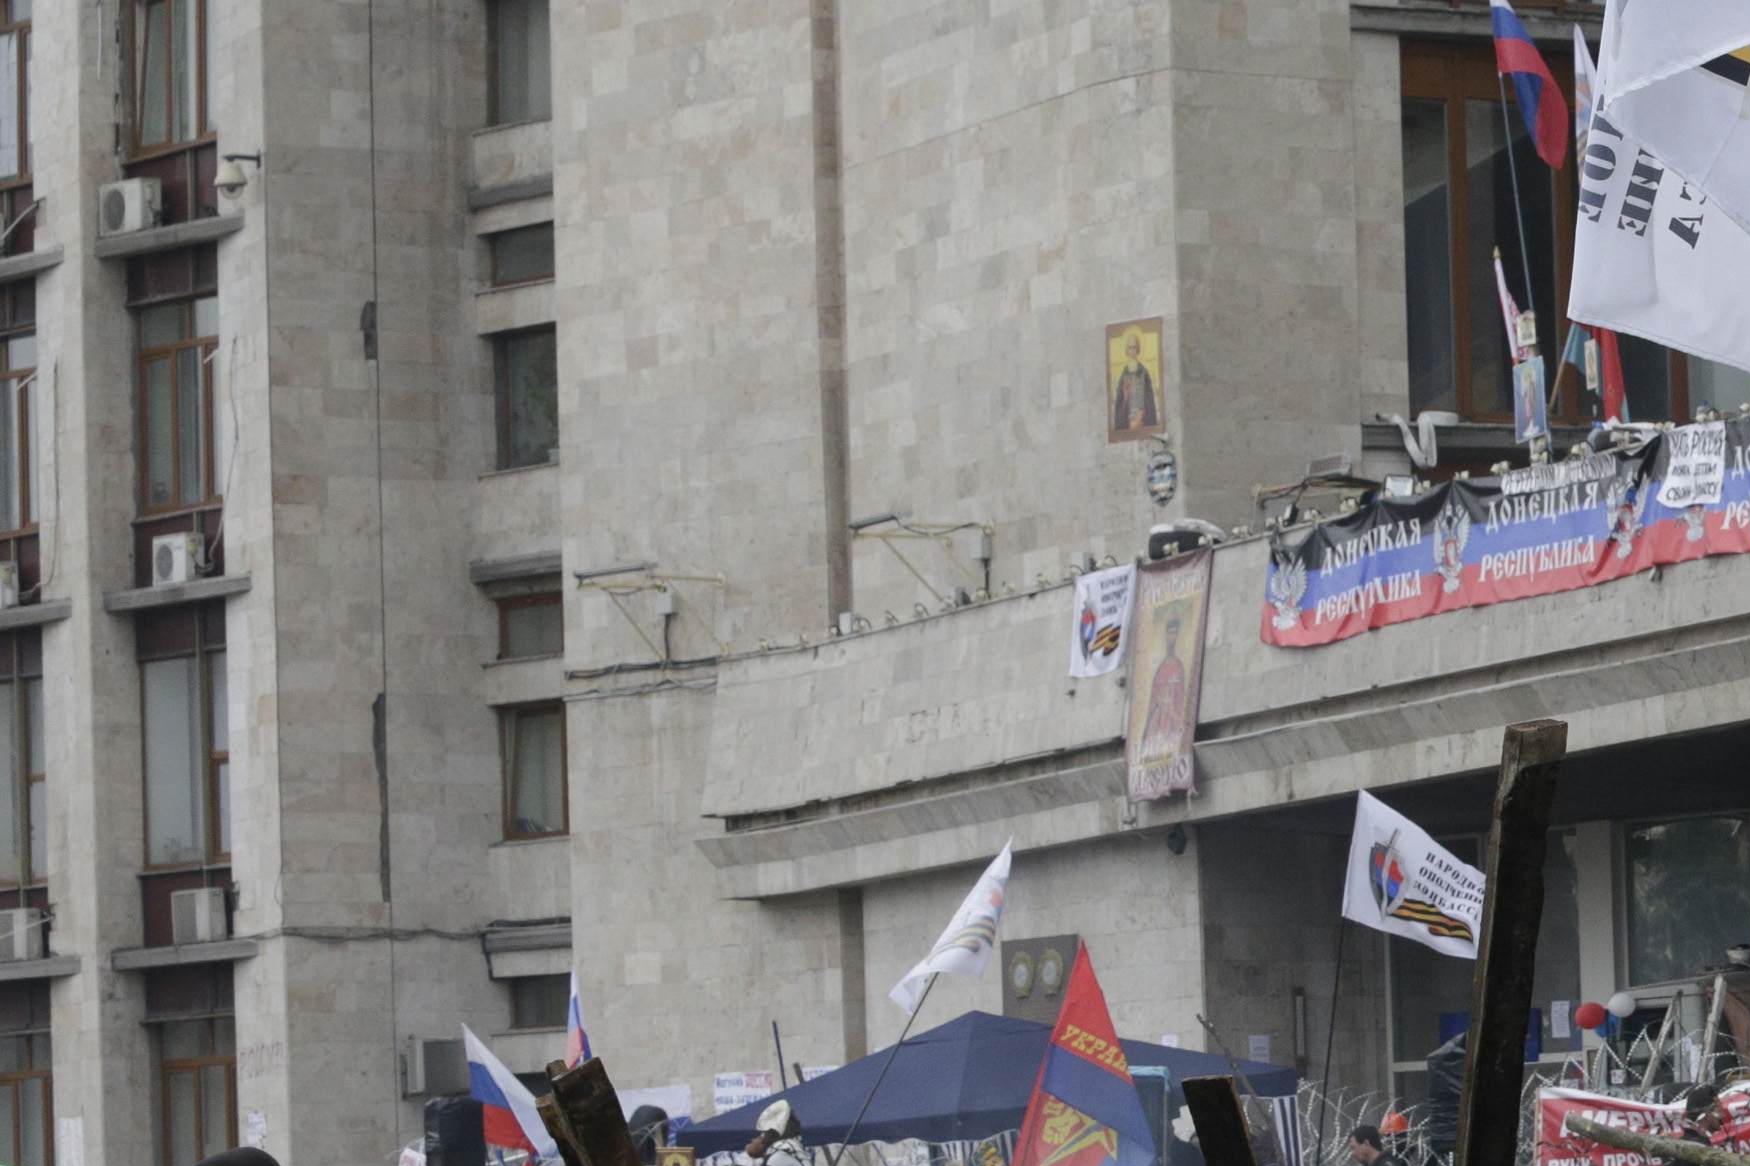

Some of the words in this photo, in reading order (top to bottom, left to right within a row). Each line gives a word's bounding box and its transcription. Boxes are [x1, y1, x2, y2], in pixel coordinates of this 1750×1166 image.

[1485, 481, 1600, 534] ДОНЕЦКАЯ
[1478, 535, 1596, 582] РЕСПУБЛИКА
[1426, 852, 1486, 895] НАРОДНО
